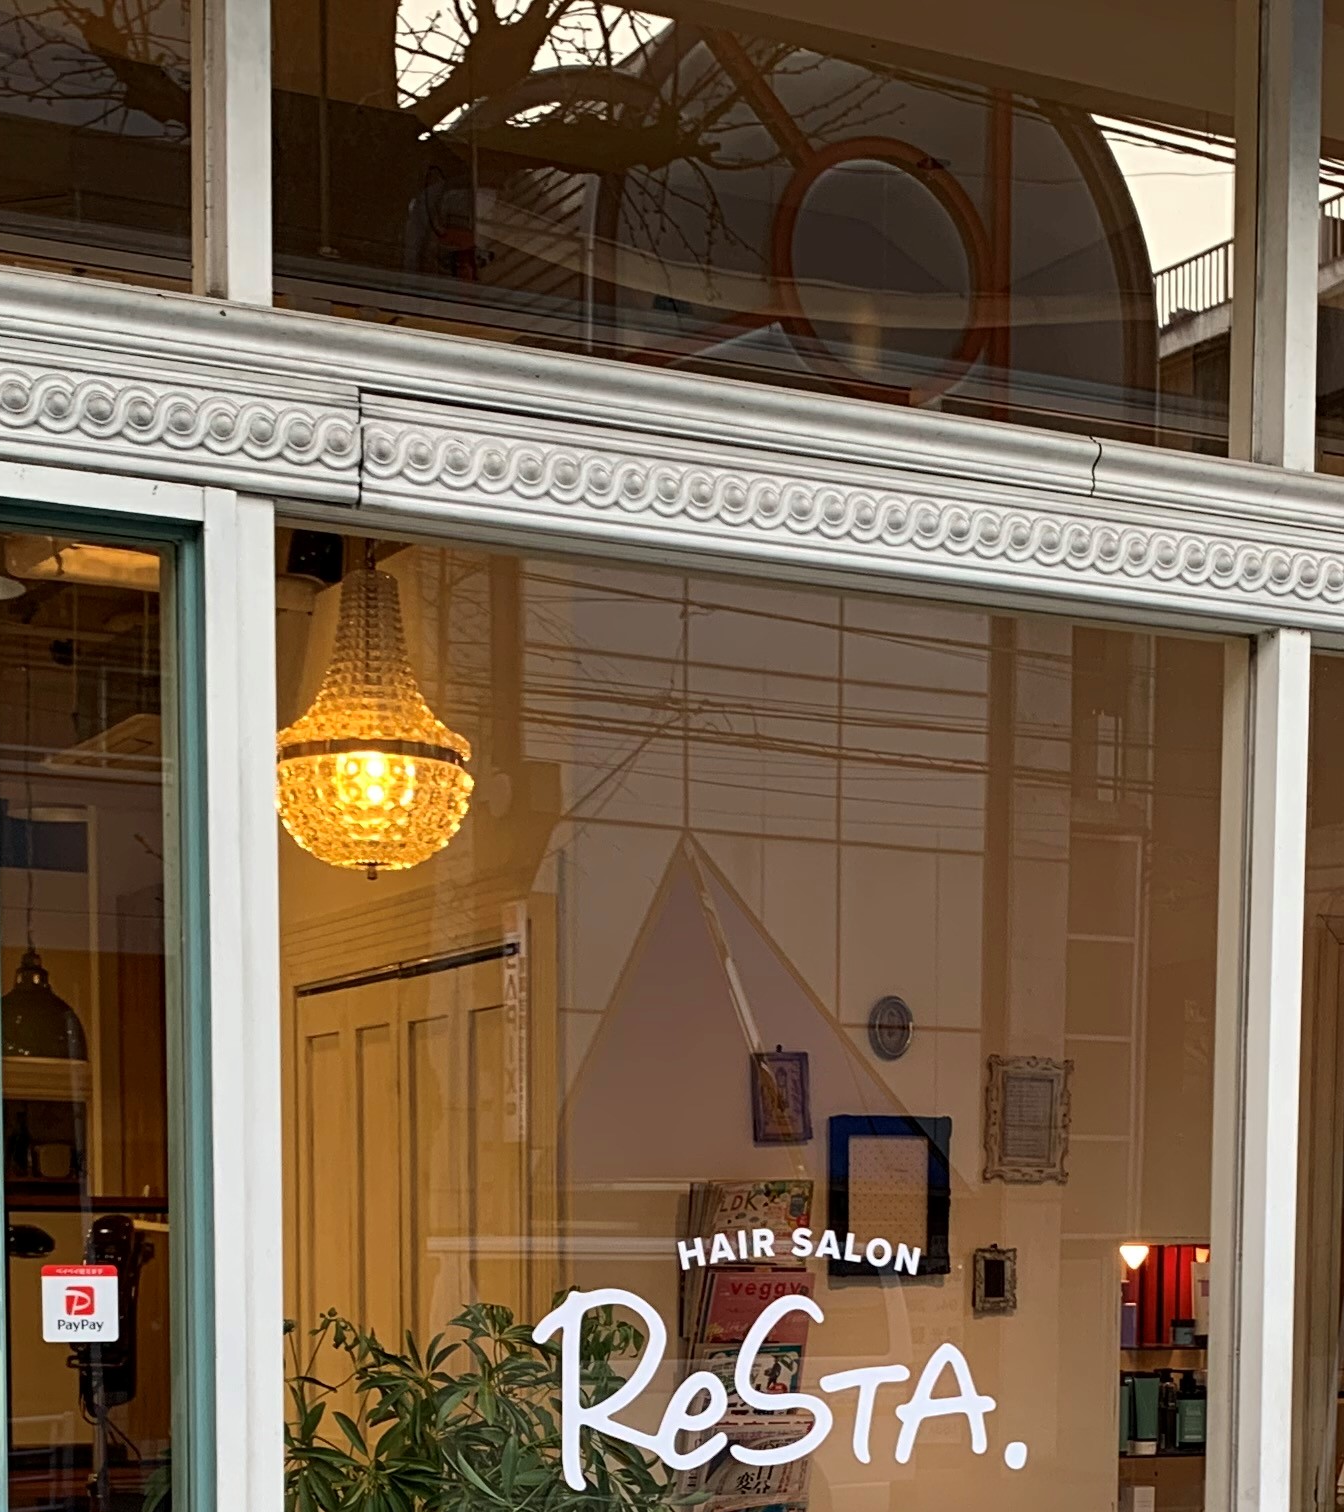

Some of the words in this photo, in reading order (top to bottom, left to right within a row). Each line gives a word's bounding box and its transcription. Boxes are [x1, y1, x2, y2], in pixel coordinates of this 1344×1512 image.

[676, 1228, 776, 1271] HAIR
[791, 1228, 922, 1276] SALON
[57, 1319, 104, 1332] PayPay
